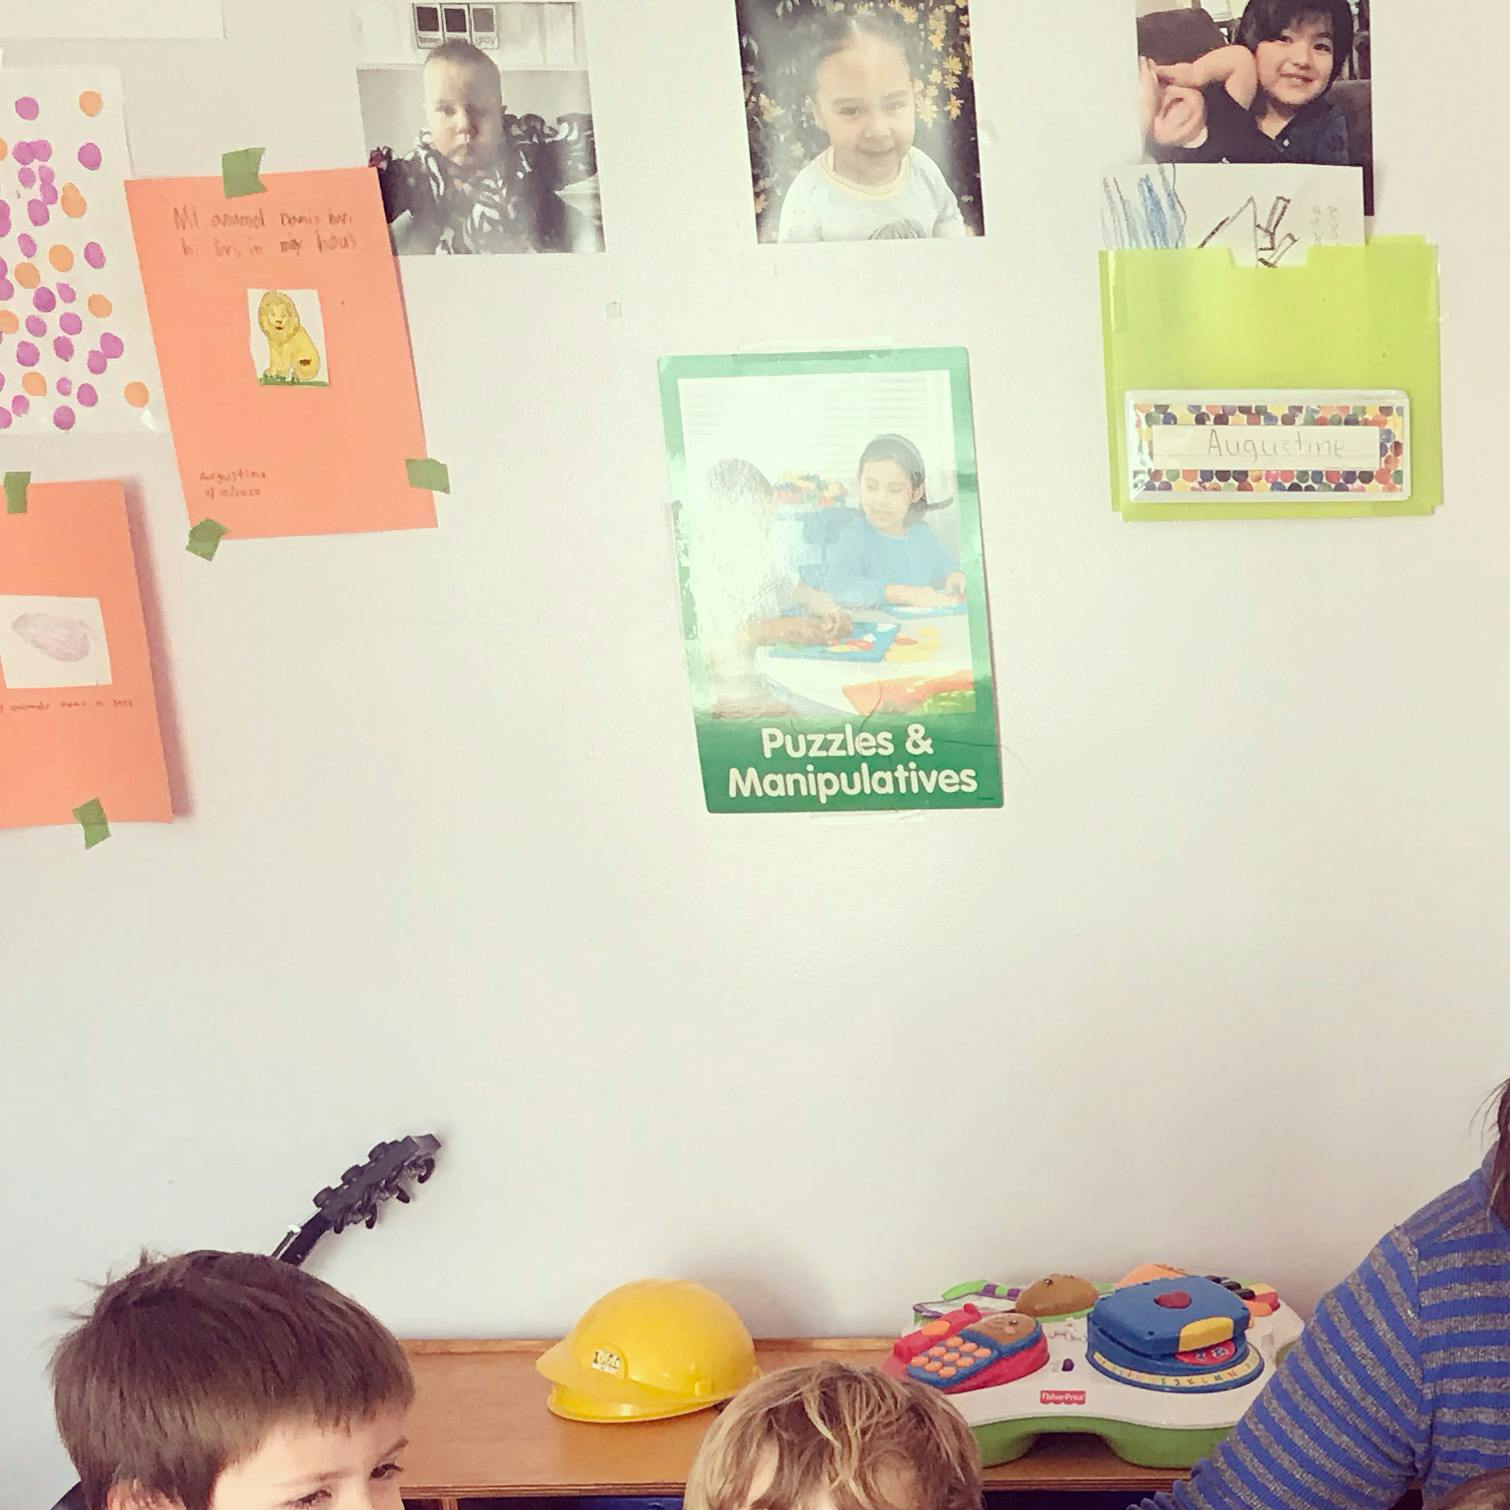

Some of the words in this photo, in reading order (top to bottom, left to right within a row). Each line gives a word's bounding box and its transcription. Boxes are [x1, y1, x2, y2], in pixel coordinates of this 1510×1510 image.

[1208, 428, 1346, 463] Augustine
[760, 722, 894, 759] Puzzles
[904, 722, 934, 756] &
[727, 761, 979, 804] Manipulatives
